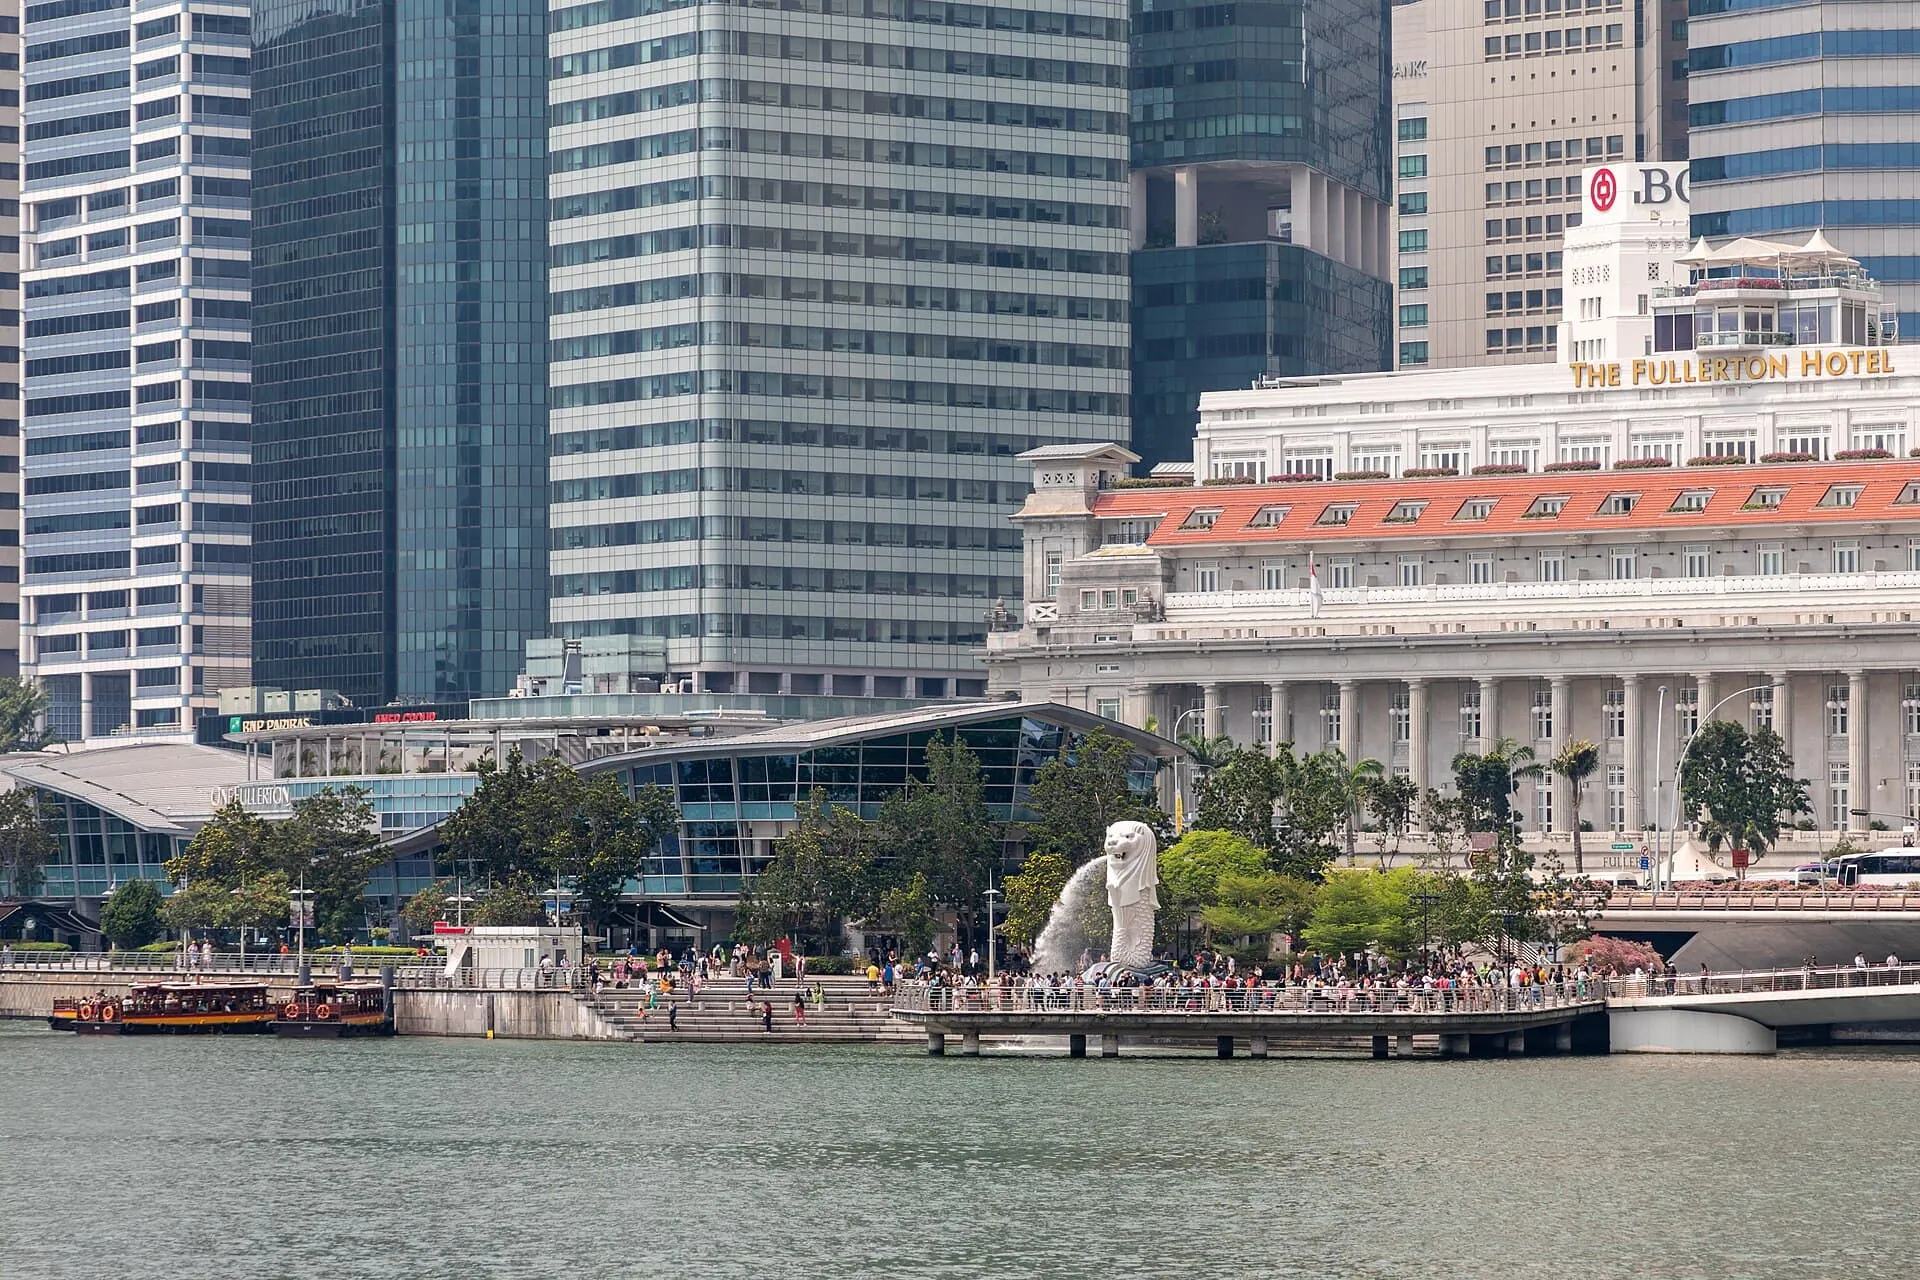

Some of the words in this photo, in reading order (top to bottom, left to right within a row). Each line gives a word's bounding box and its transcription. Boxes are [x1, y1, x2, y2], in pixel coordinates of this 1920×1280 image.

[1569, 362, 1620, 388] THE
[1632, 354, 1788, 385] FULLERTON
[1801, 349, 1895, 377] HOTEL
[243, 719, 265, 732] BNP
[267, 717, 310, 731] PARIBAS
